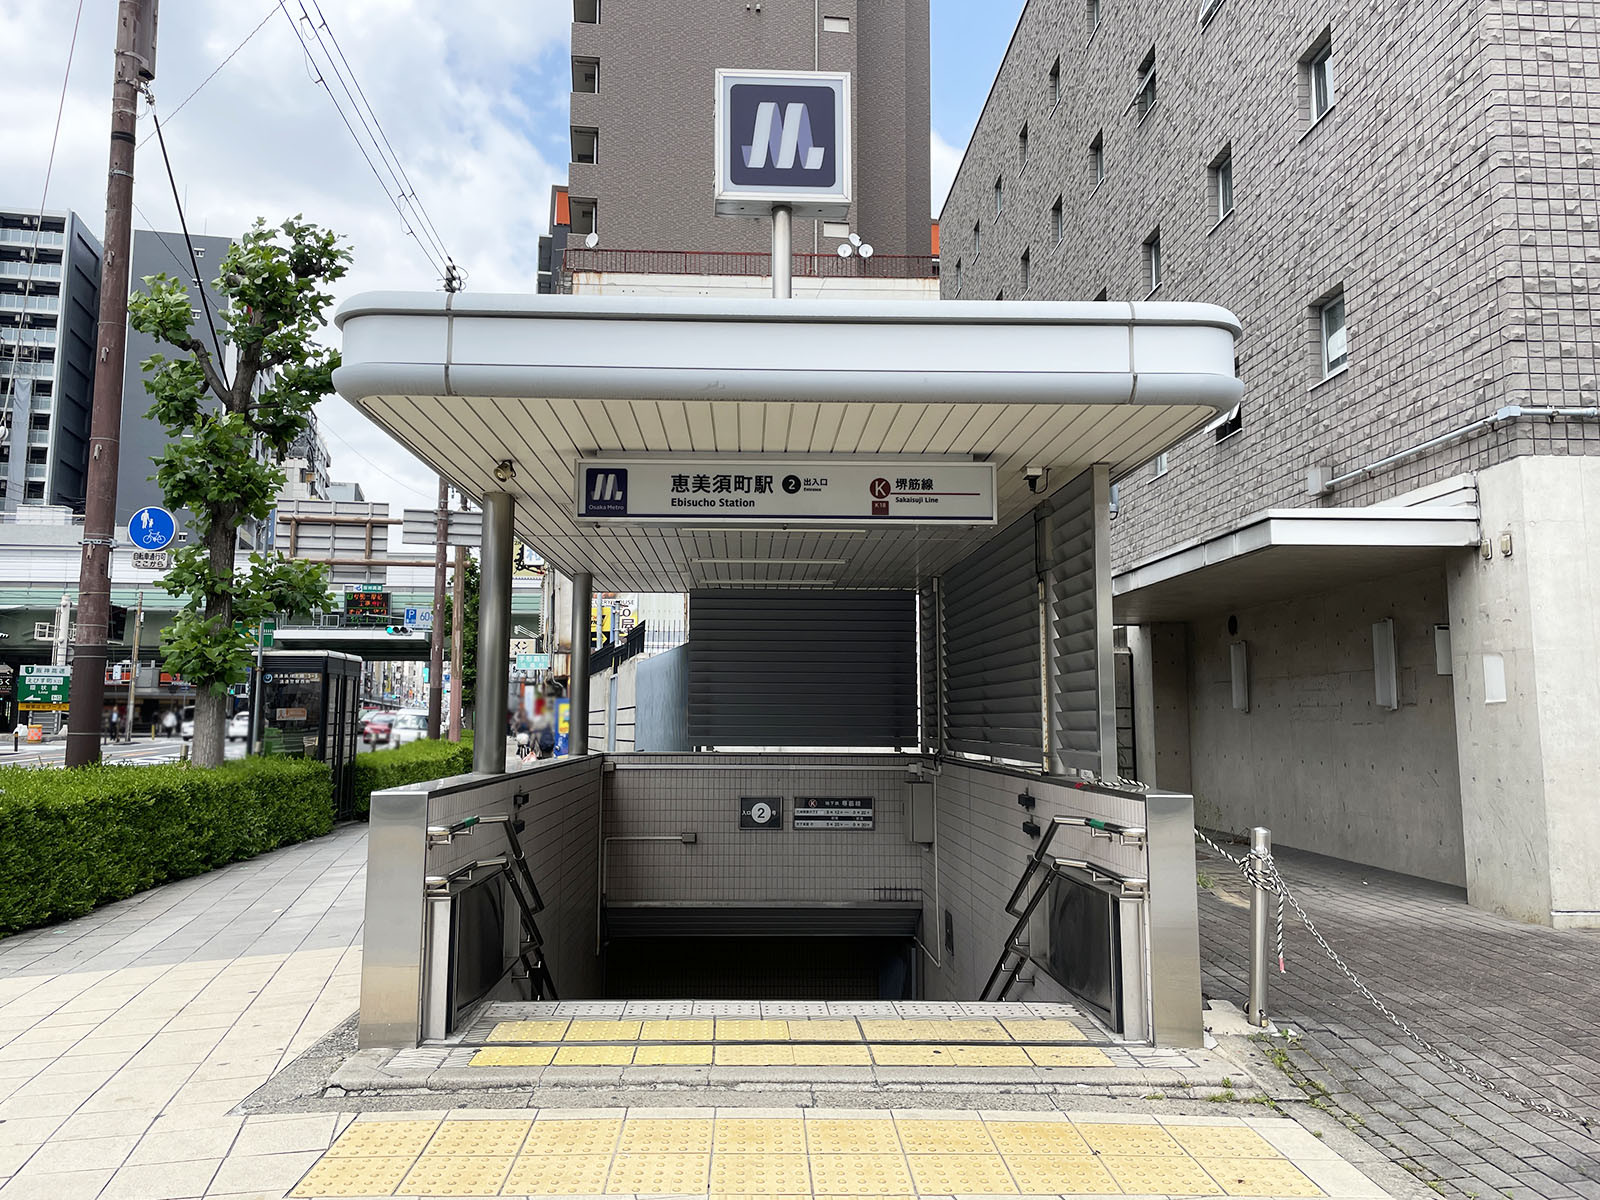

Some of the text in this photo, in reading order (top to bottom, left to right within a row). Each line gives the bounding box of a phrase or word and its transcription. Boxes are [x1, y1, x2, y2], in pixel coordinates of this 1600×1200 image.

[670, 474, 774, 494] 恵美須町駅
[803, 478, 828, 486] 出入口
[895, 478, 934, 491] 堺筋線
[875, 481, 886, 496] K
[670, 498, 755, 508] Ebisucho Station
[895, 496, 923, 504] Sakaisuji
[757, 807, 765, 818] 2
